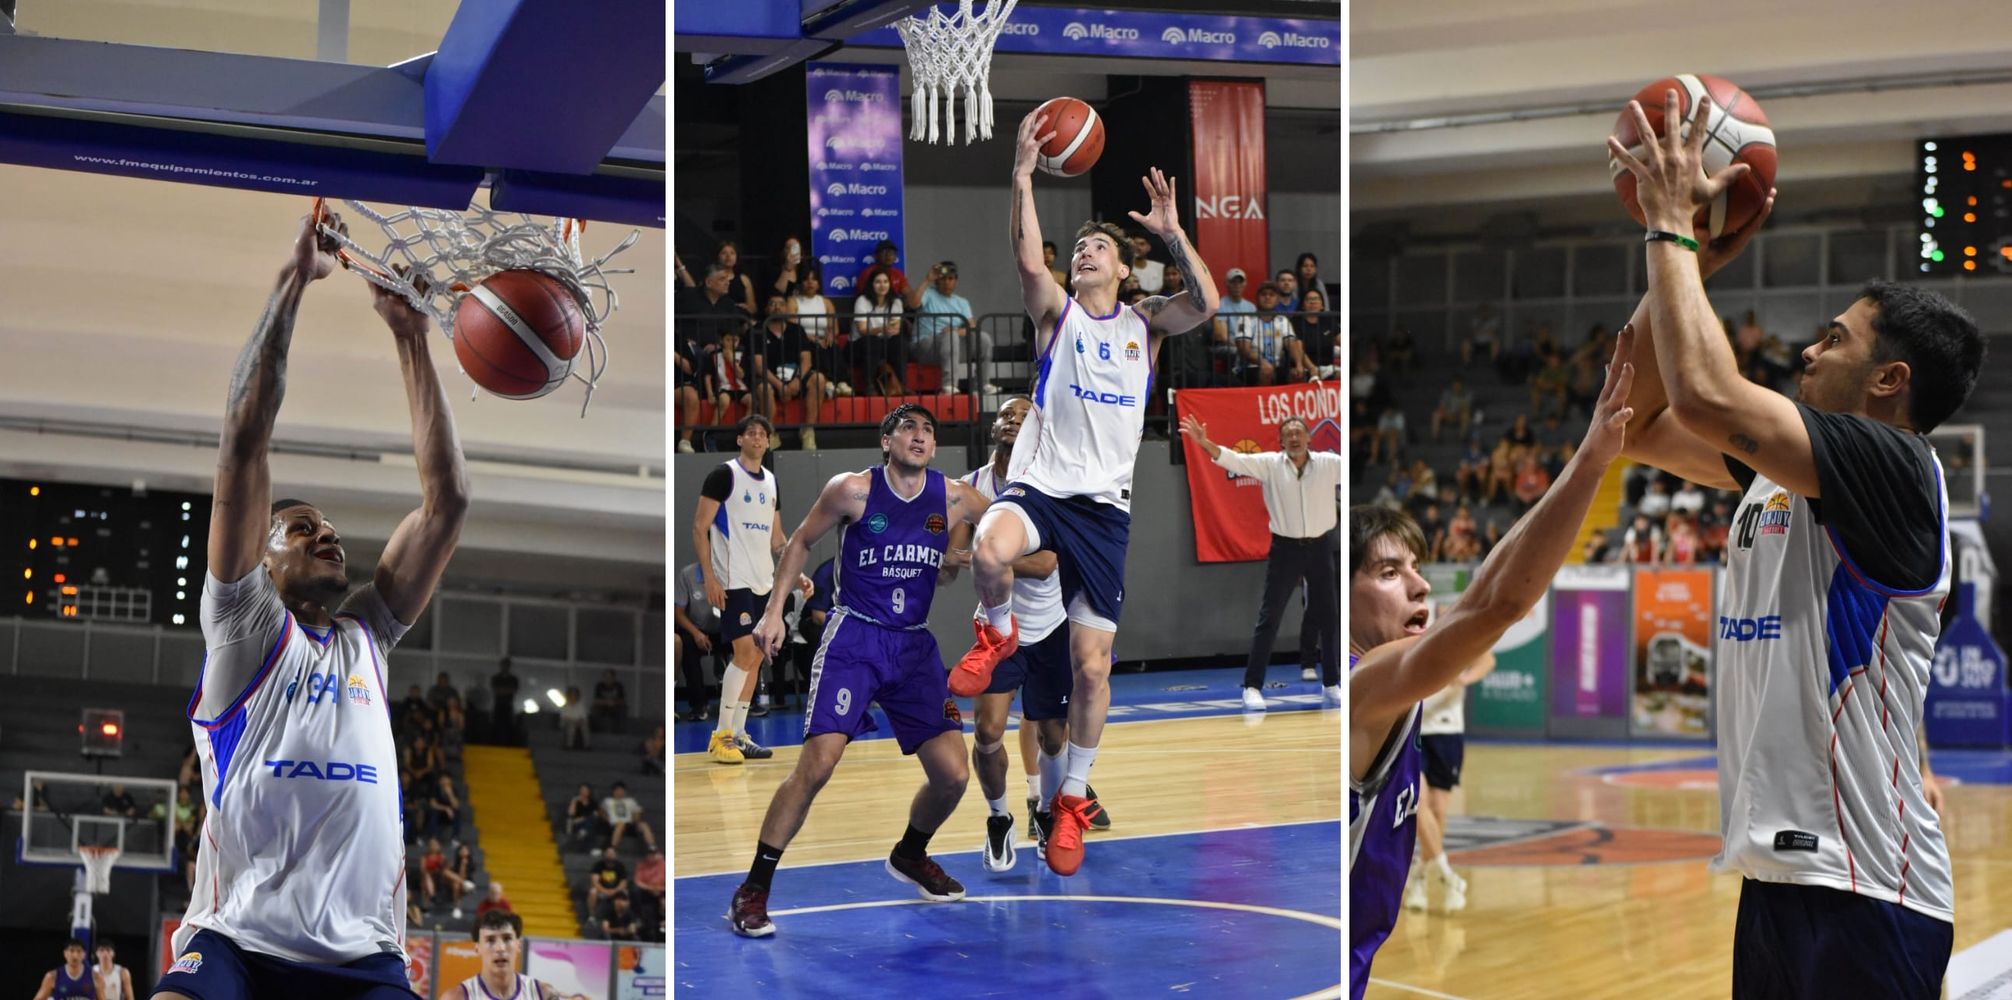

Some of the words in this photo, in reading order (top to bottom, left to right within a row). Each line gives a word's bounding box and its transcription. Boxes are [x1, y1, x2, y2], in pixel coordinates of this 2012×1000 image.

[1000, 22, 1039, 36] acro
[1090, 24, 1139, 40] Macro
[1188, 29, 1236, 44] Macro
[1283, 33, 1329, 48] Macro
[846, 90, 884, 102] Macro
[74, 154, 318, 186] www.fmequipamientos.com.ar
[848, 183, 887, 196] Macro
[1195, 195, 1265, 220] NGA
[849, 229, 888, 241] Macro
[1098, 341, 1111, 361] 6
[1069, 383, 1136, 408] TADE
[1257, 392, 1292, 425] LOS
[759, 491, 766, 505] 8
[1736, 502, 1765, 549] 10
[858, 547, 878, 568] EL
[882, 565, 923, 580] BÁSQUET
[891, 587, 906, 615] 9
[1719, 615, 1782, 642] TADE
[307, 672, 338, 705] 34
[834, 687, 852, 716] 9
[263, 759, 378, 785] TADE
